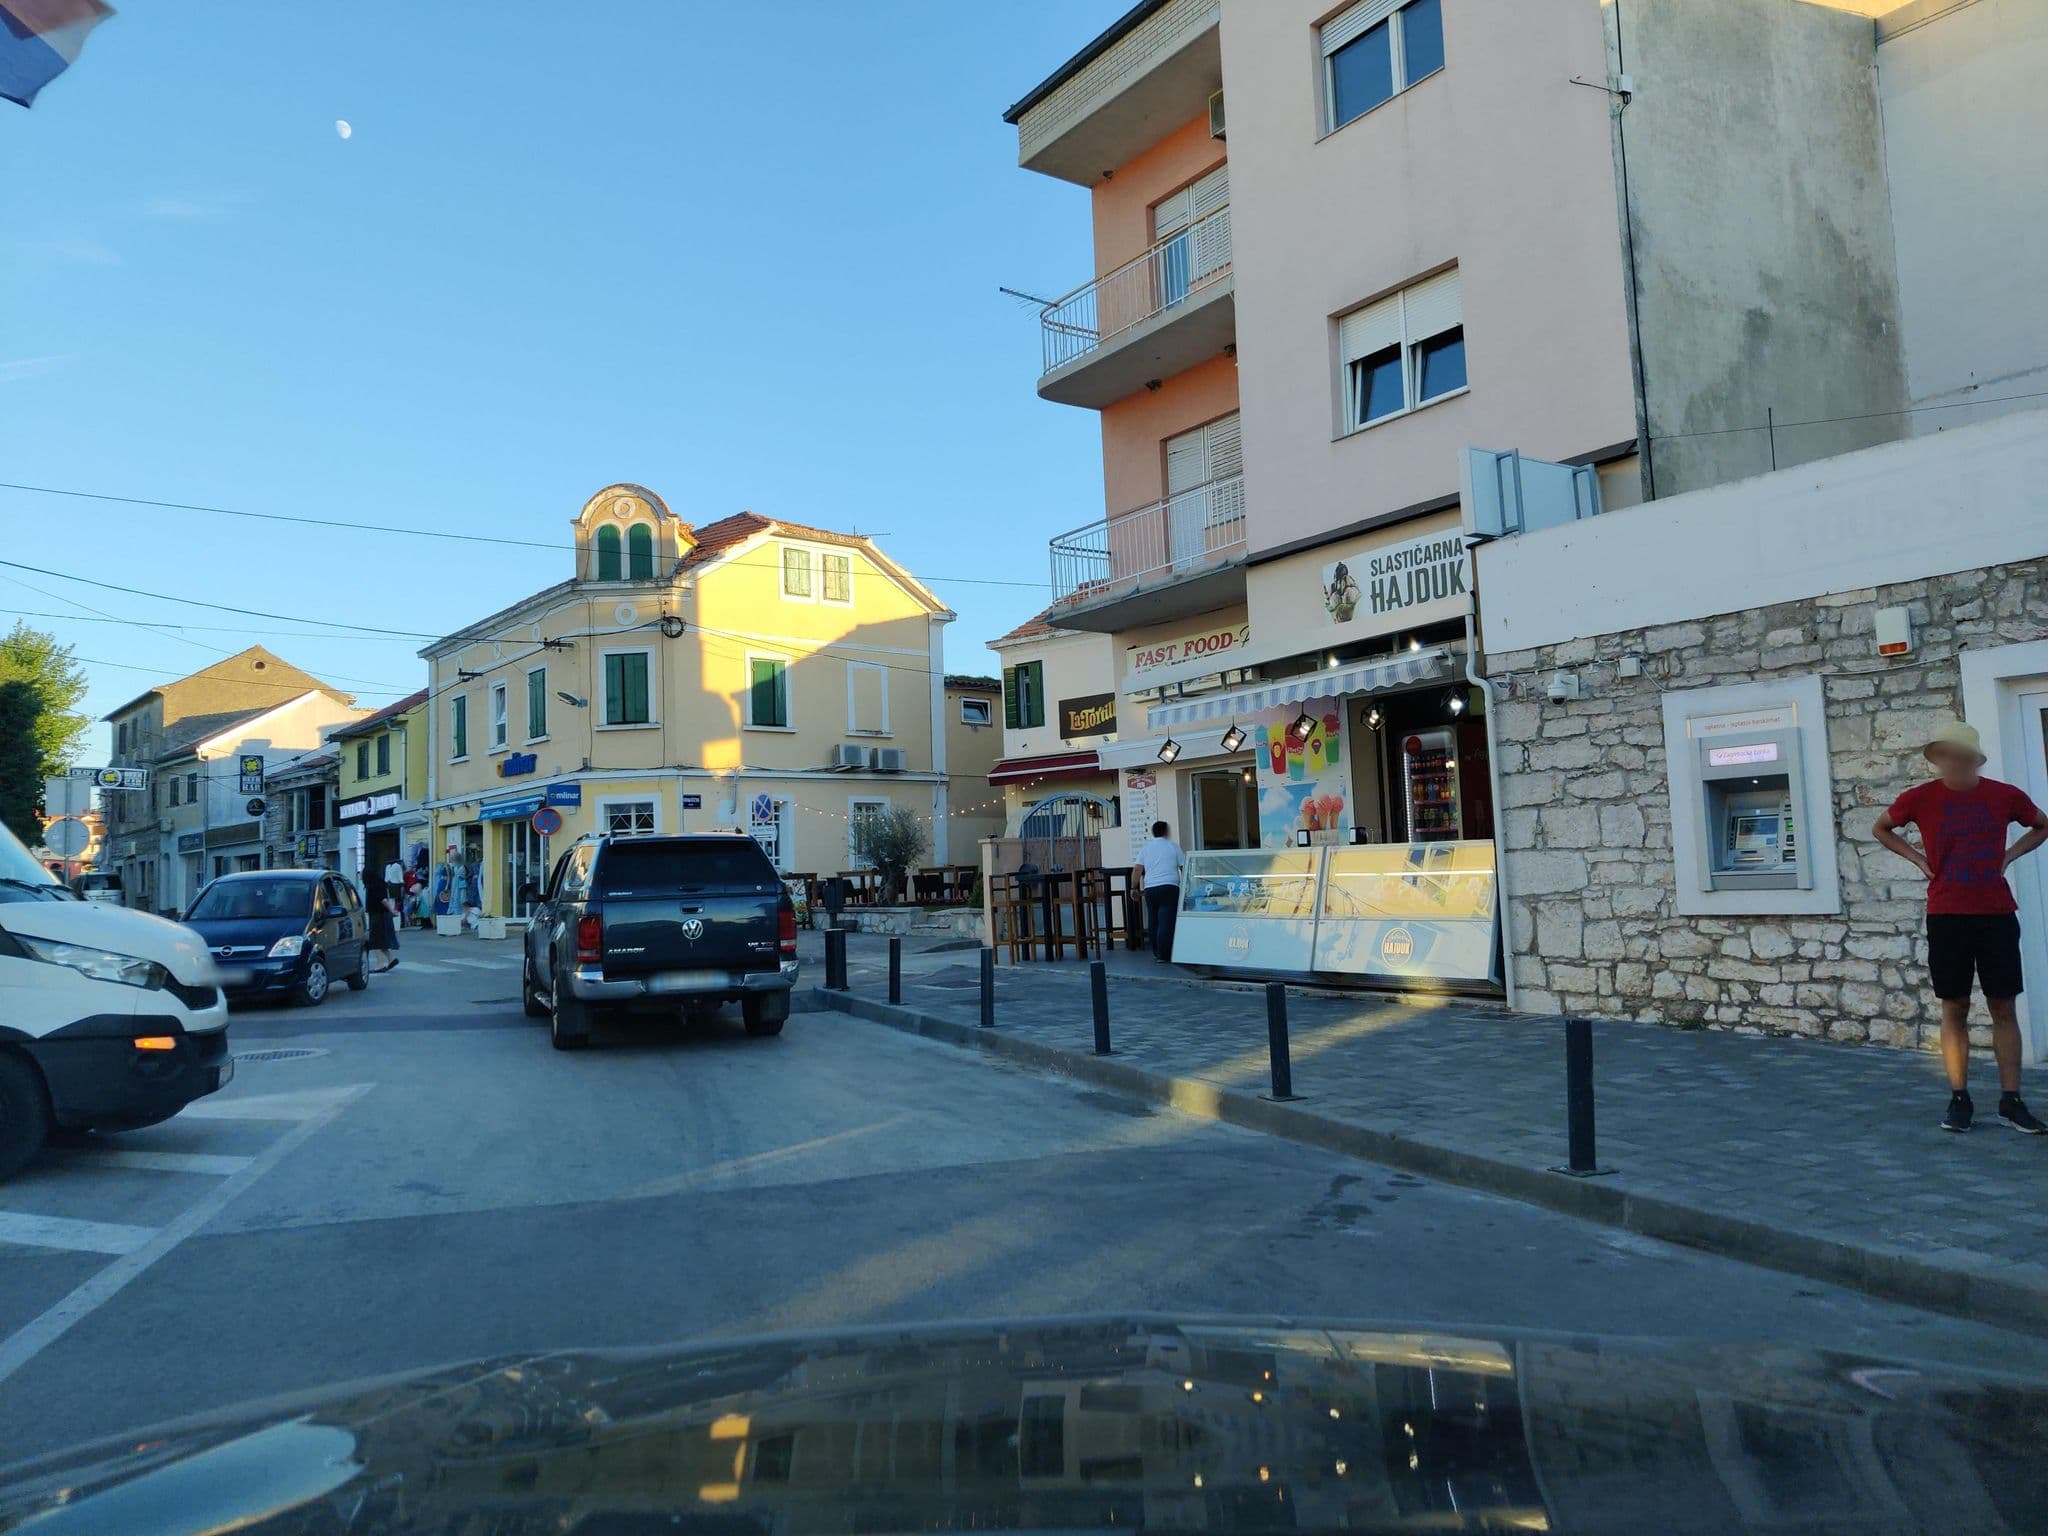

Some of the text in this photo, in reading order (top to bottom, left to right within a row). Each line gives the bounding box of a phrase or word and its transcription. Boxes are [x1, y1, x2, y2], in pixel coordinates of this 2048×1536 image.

[1370, 537, 1464, 577] SLASTIČARNA
[1370, 558, 1466, 614] HAJDUK
[1135, 644, 1177, 668] FAST
[556, 791, 579, 800] mlinar
